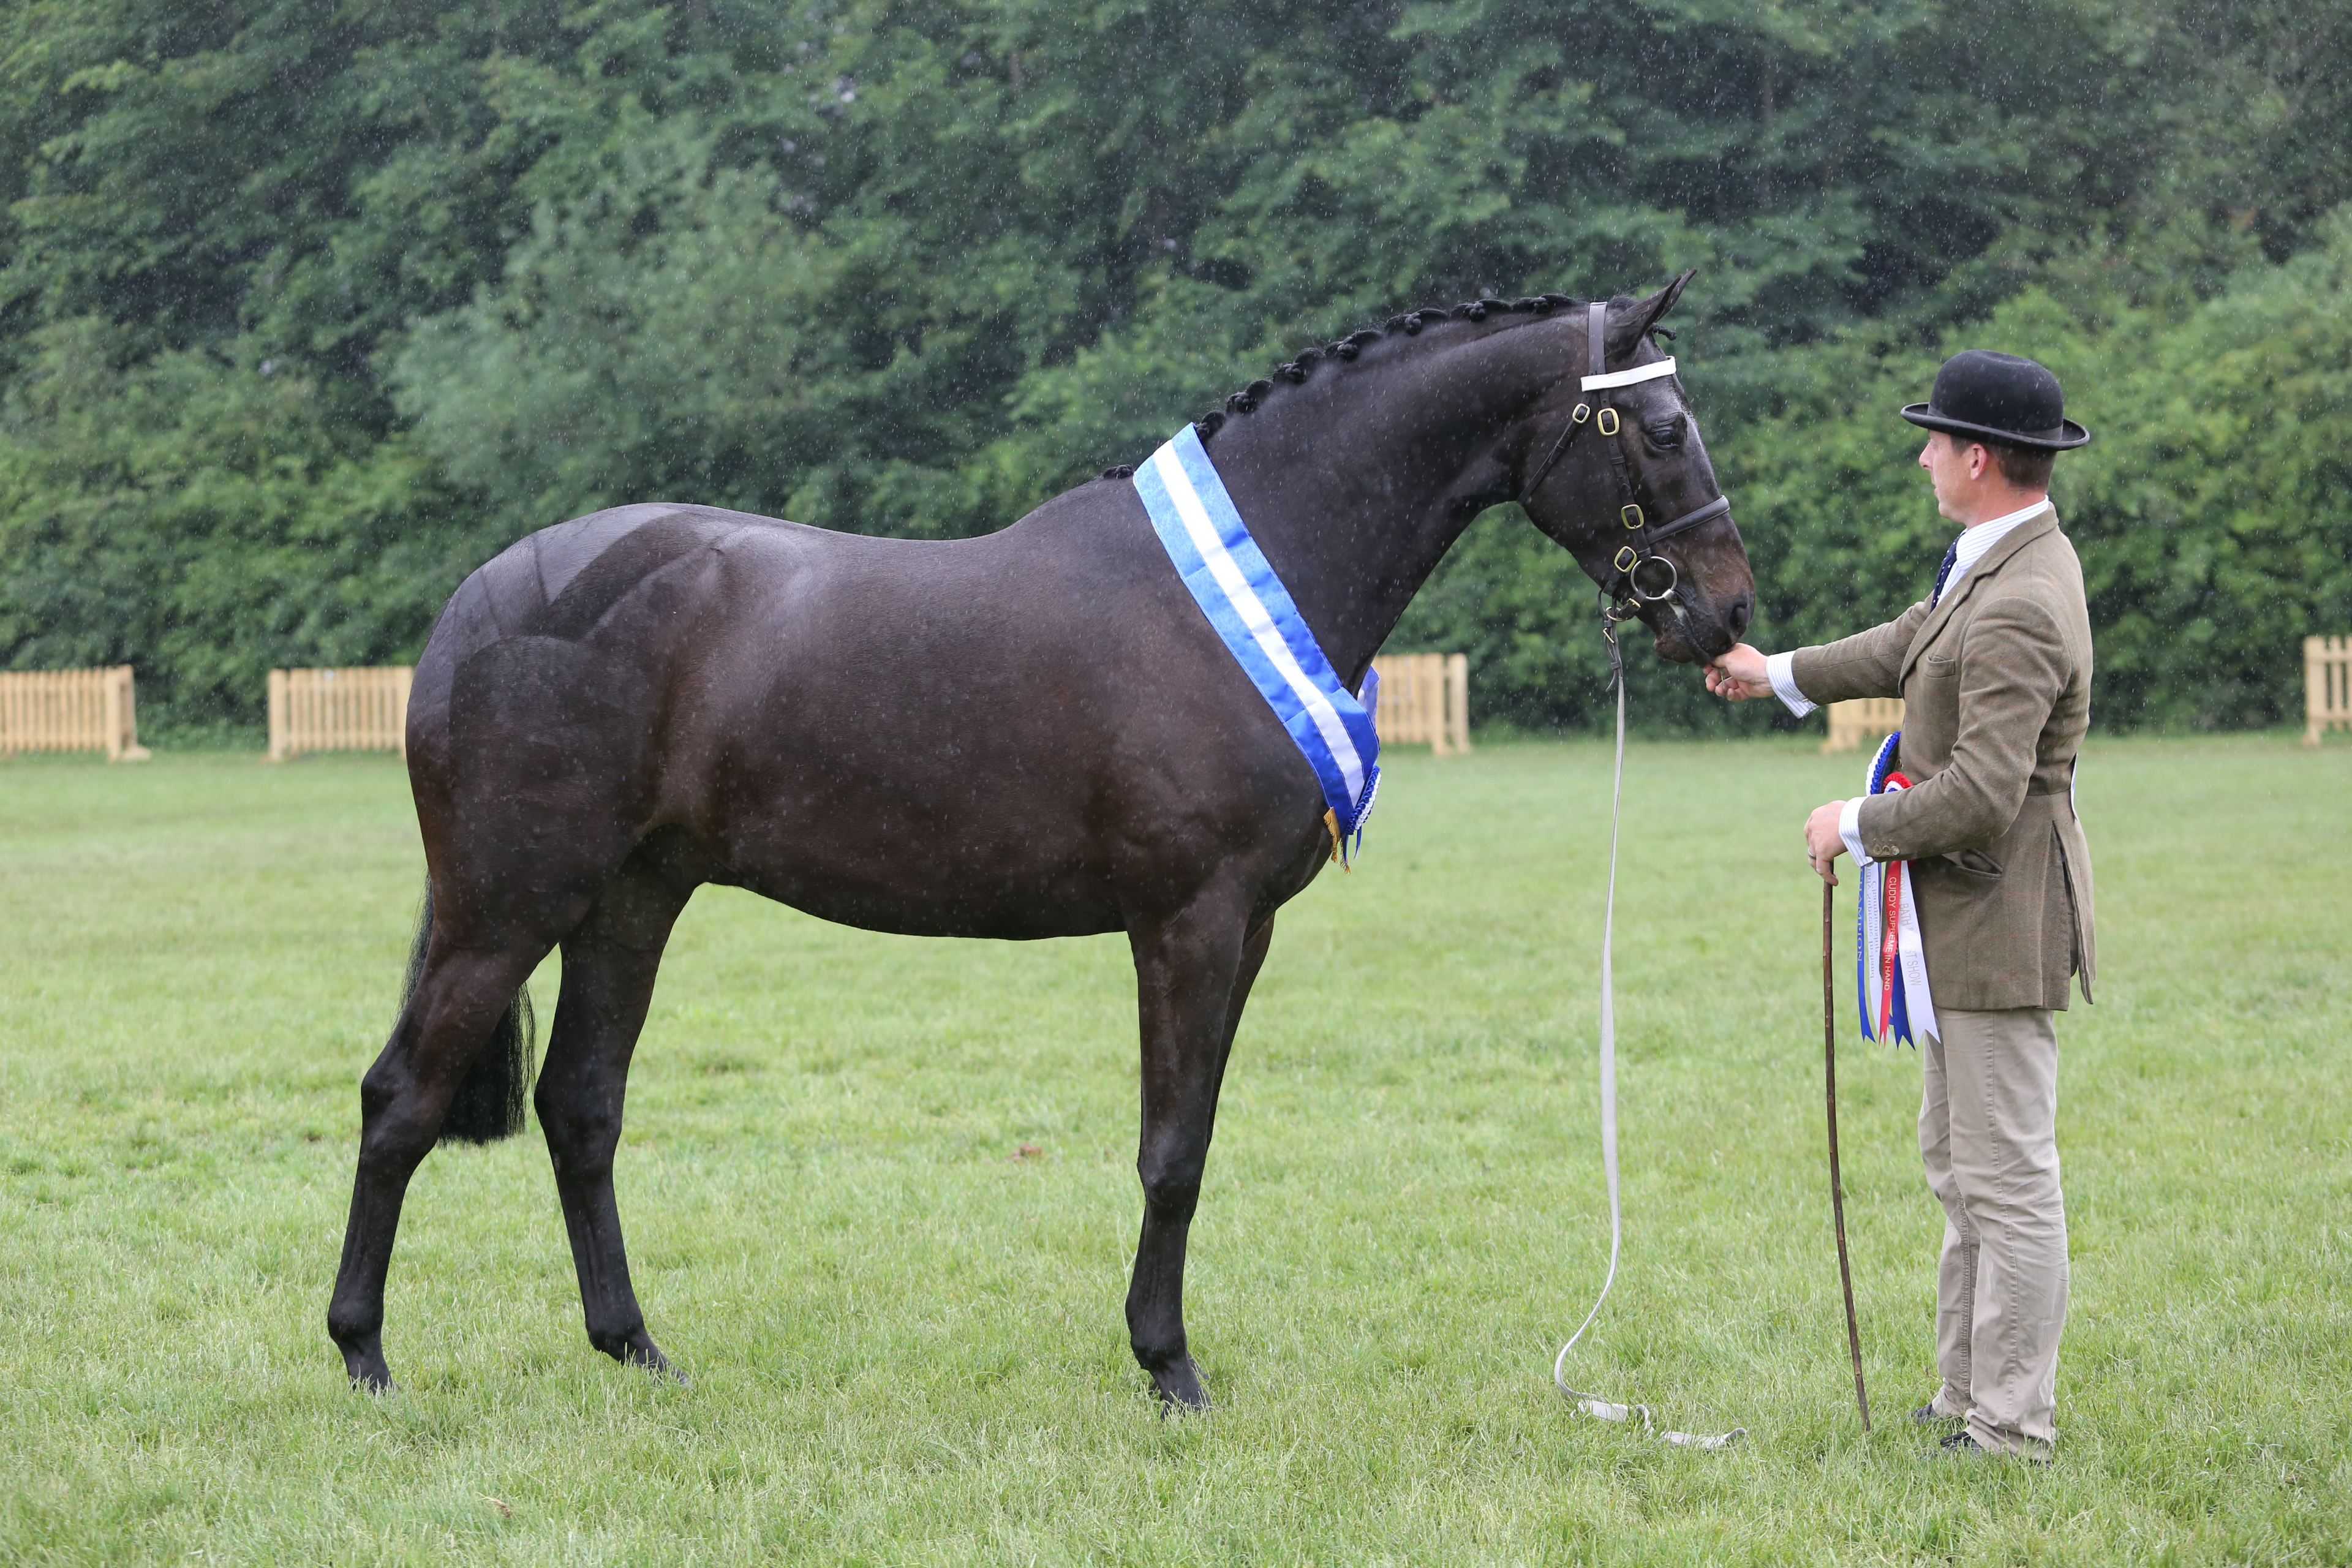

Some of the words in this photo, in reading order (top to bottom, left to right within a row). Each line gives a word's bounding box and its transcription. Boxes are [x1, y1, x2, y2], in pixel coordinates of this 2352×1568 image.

[1888, 877, 1897, 908] CUDDY
[1885, 910, 1896, 952] SUPREME
[1899, 903, 1912, 926] BATH
[1907, 960, 1922, 986] SHOW
[1885, 955, 1891, 963] IN
